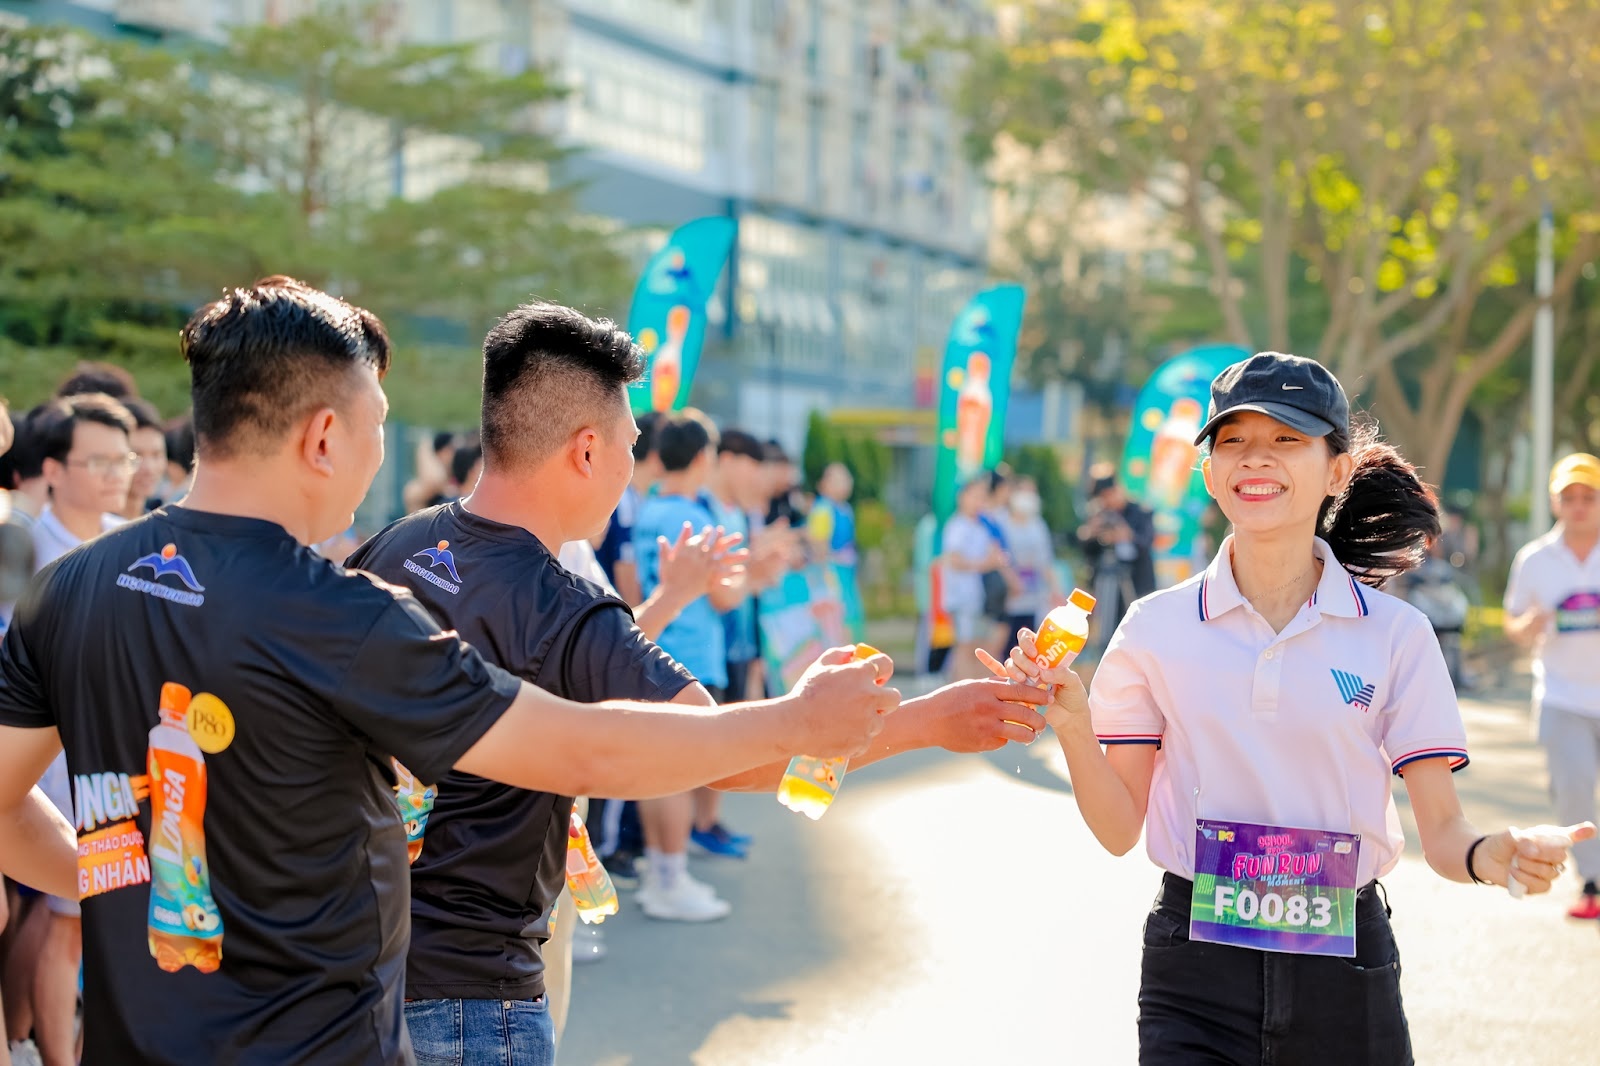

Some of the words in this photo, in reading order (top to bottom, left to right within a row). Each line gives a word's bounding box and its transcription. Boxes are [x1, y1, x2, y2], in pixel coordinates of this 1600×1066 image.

[152, 768, 187, 868] LONGA
[1258, 834, 1293, 848] SCHOOL
[93, 852, 151, 891] NHÃN
[1233, 854, 1276, 881] FUN
[1277, 852, 1321, 876] RUN
[1261, 874, 1289, 882] HAPPY
[1267, 877, 1305, 887] MOMENT
[1214, 885, 1332, 928] F0083
